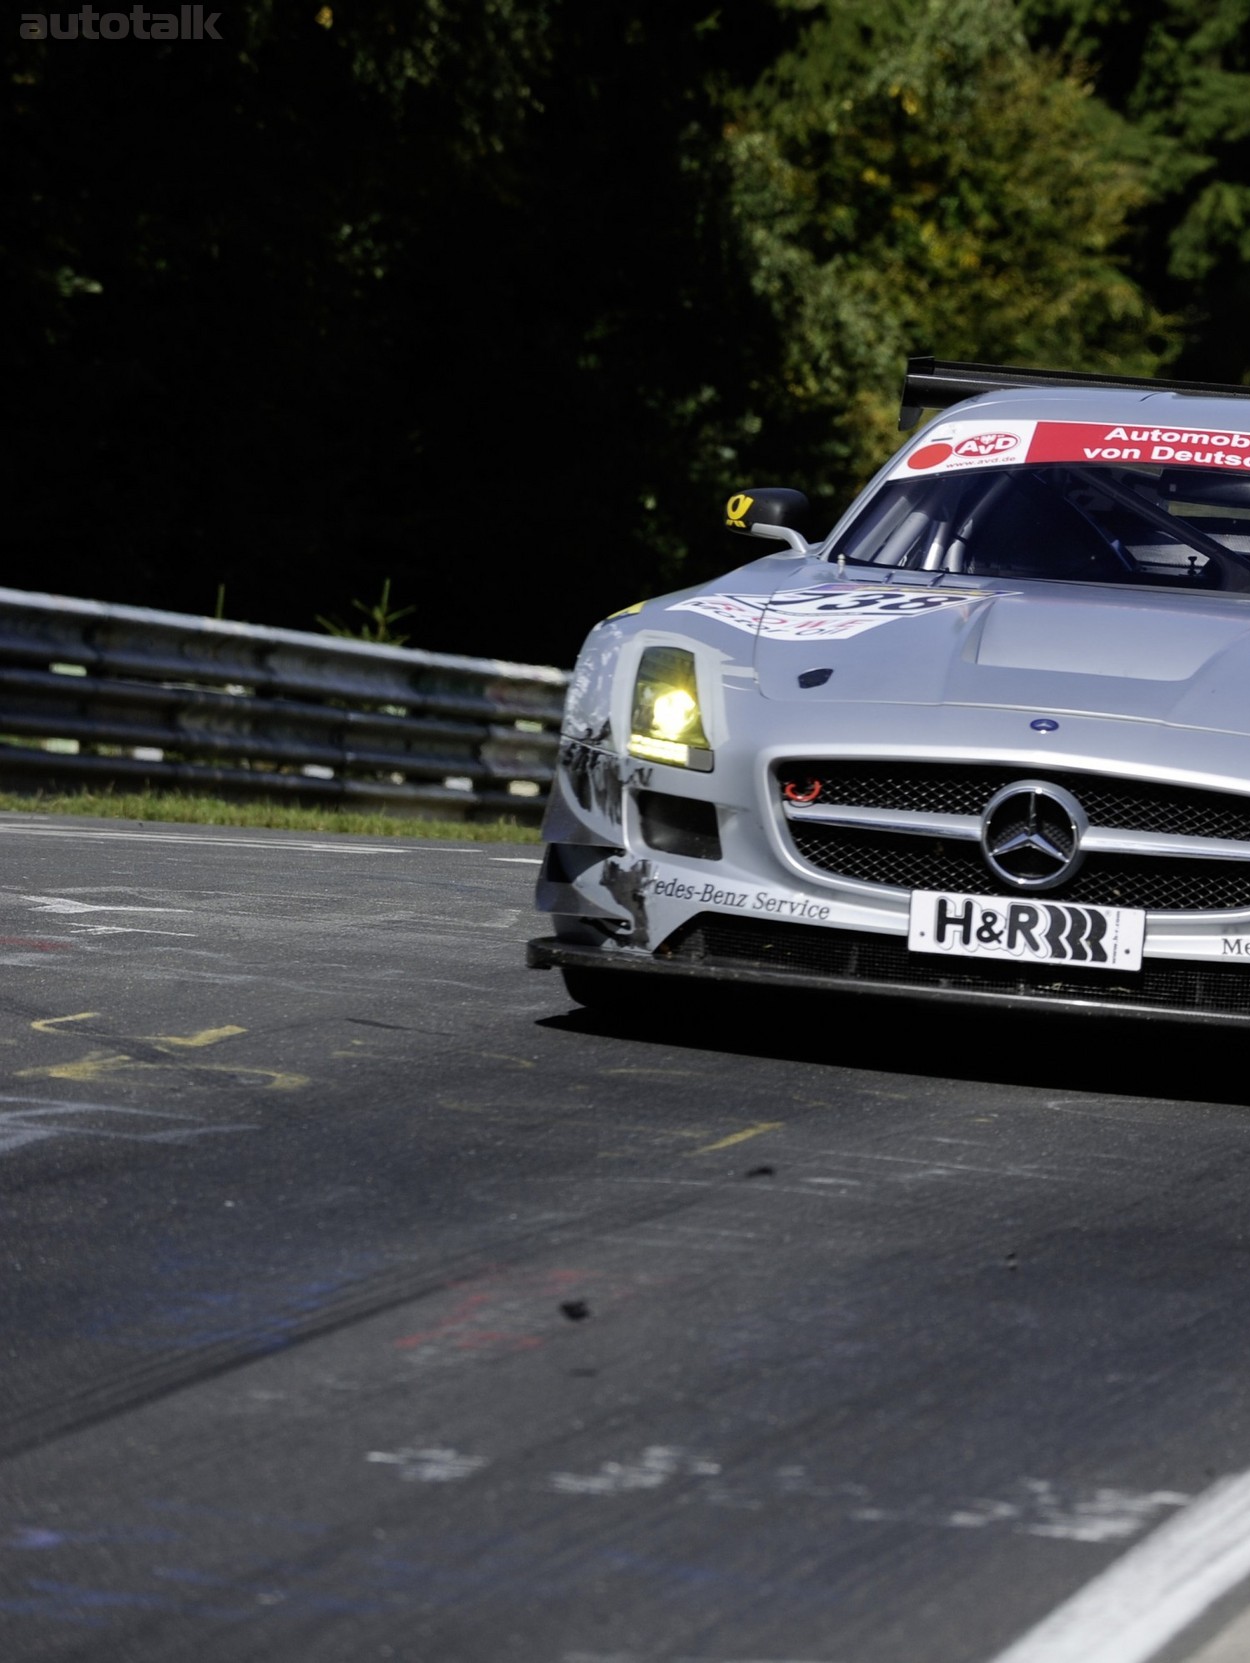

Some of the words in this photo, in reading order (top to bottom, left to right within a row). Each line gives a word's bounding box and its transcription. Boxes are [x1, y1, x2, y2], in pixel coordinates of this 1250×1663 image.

[1082, 446, 1142, 460] von
[946, 455, 1016, 469] www.avd.de
[757, 592, 968, 611] 738
[752, 891, 831, 920] Service
